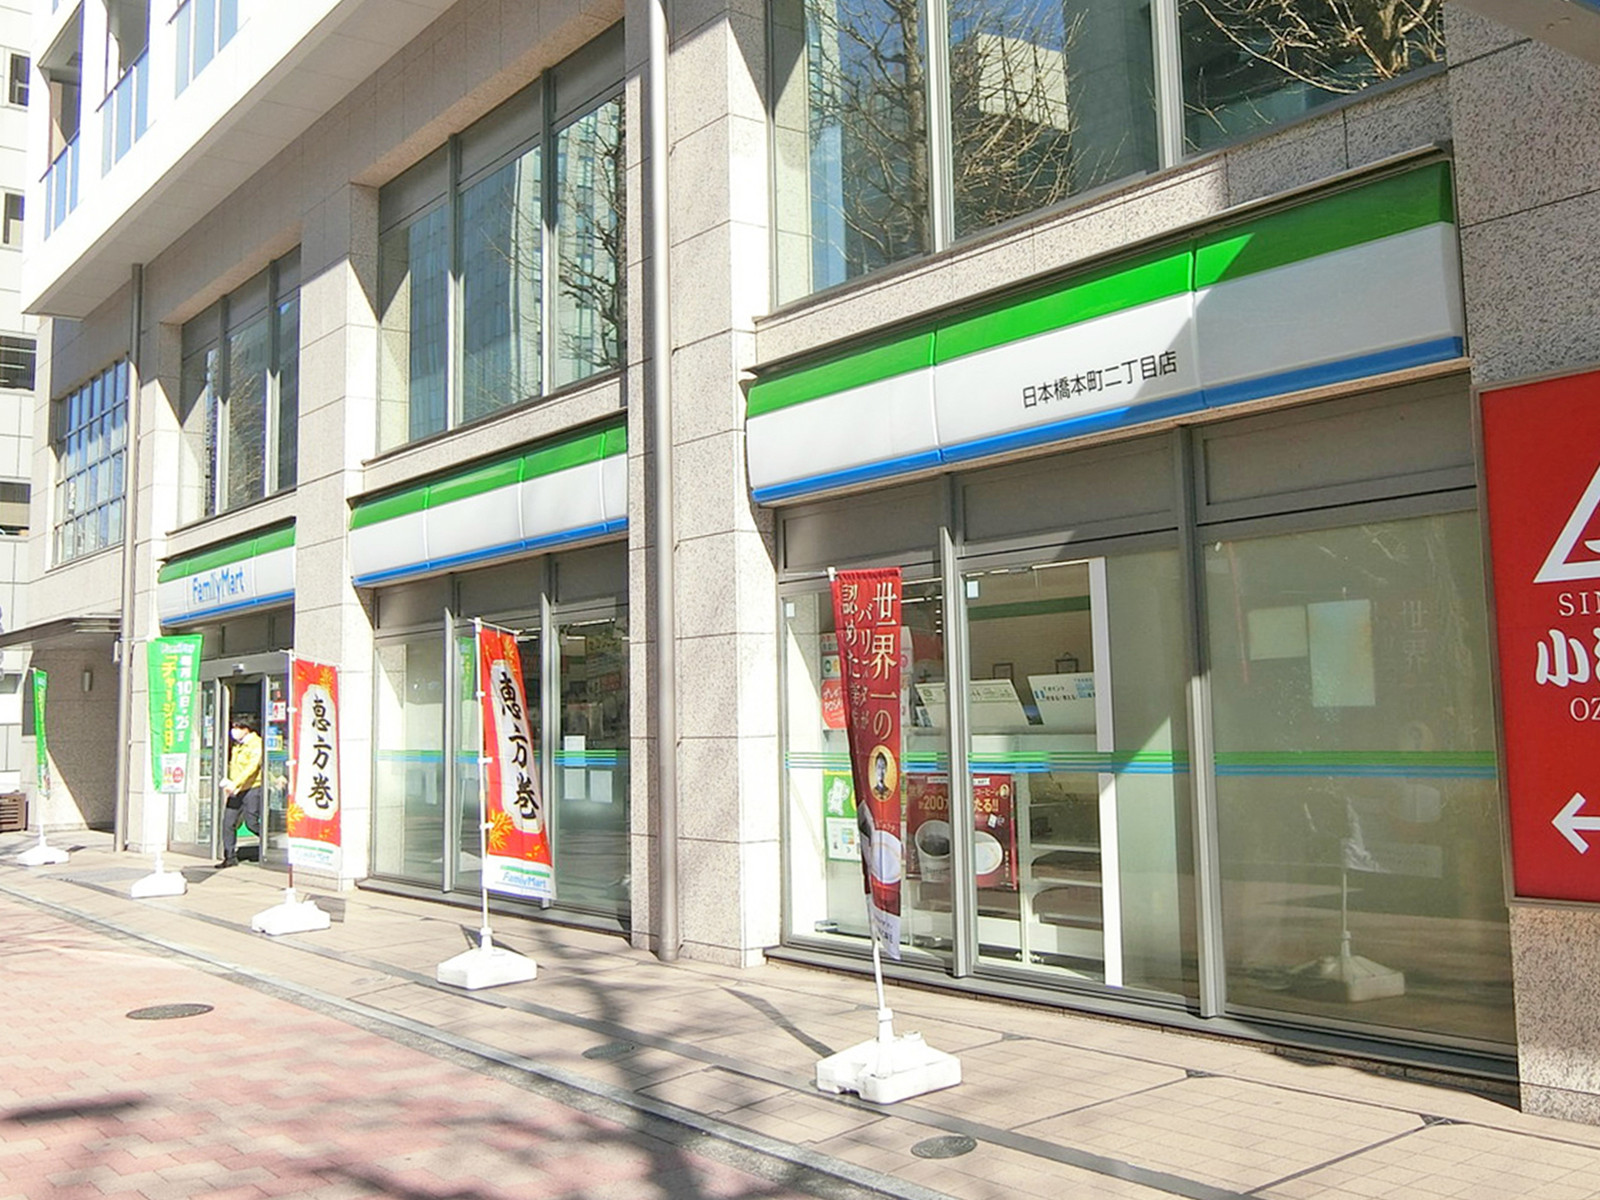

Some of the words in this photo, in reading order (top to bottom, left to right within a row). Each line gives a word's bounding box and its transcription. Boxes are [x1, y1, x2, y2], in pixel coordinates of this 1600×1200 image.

[1023, 350, 1177, 408] 日本橋本町二丁目店
[192, 567, 245, 604] FamilyMart
[870, 582, 897, 740] 世界一の
[1536, 628, 1600, 687] 小
[308, 692, 334, 810] 恵方巻
[499, 672, 539, 820] 恵方巻
[503, 871, 547, 889] FamilyMart
